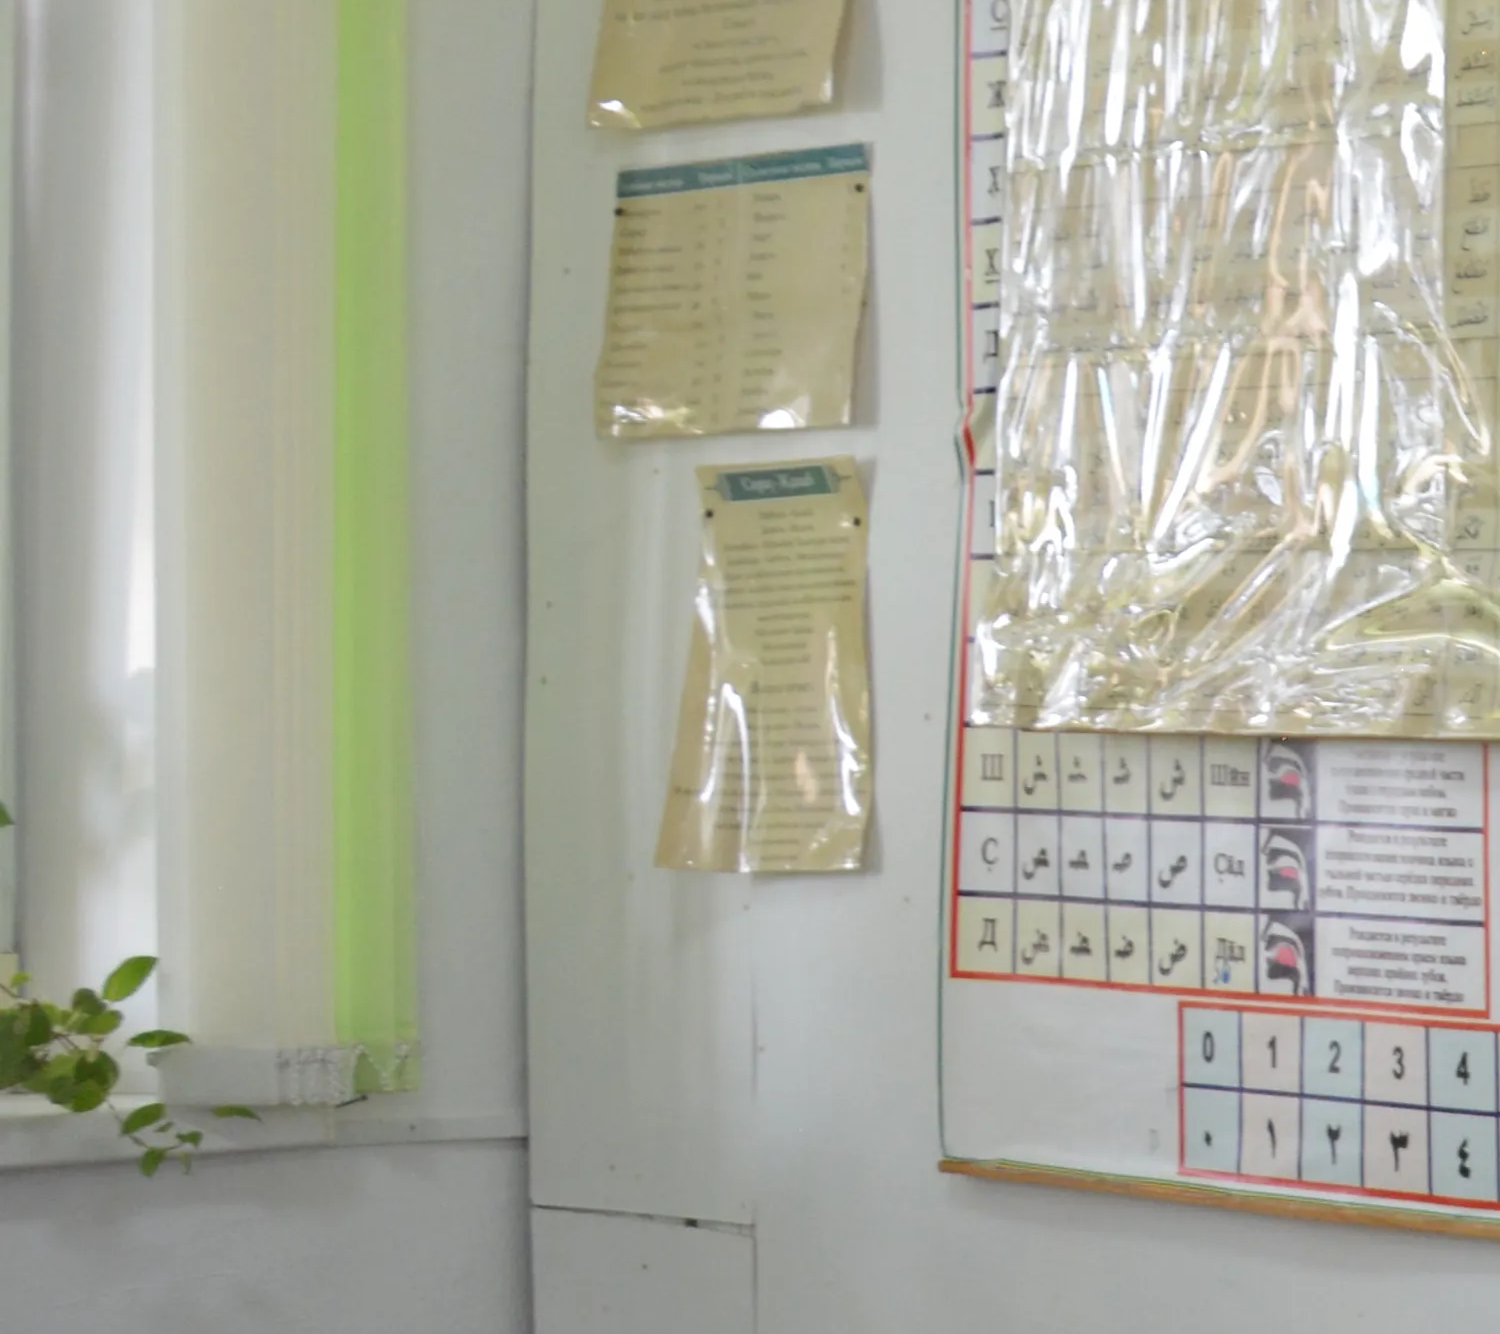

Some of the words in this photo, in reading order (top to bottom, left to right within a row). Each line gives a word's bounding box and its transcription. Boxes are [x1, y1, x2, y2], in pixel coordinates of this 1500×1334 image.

[981, 754, 1004, 781] Ш
[978, 918, 996, 950] Д
[1203, 1031, 1214, 1063] 0
[1268, 1036, 1276, 1068] 1
[1328, 1041, 1341, 1073] 2
[1393, 1047, 1404, 1080] 3
[1456, 1052, 1470, 1084] 4
